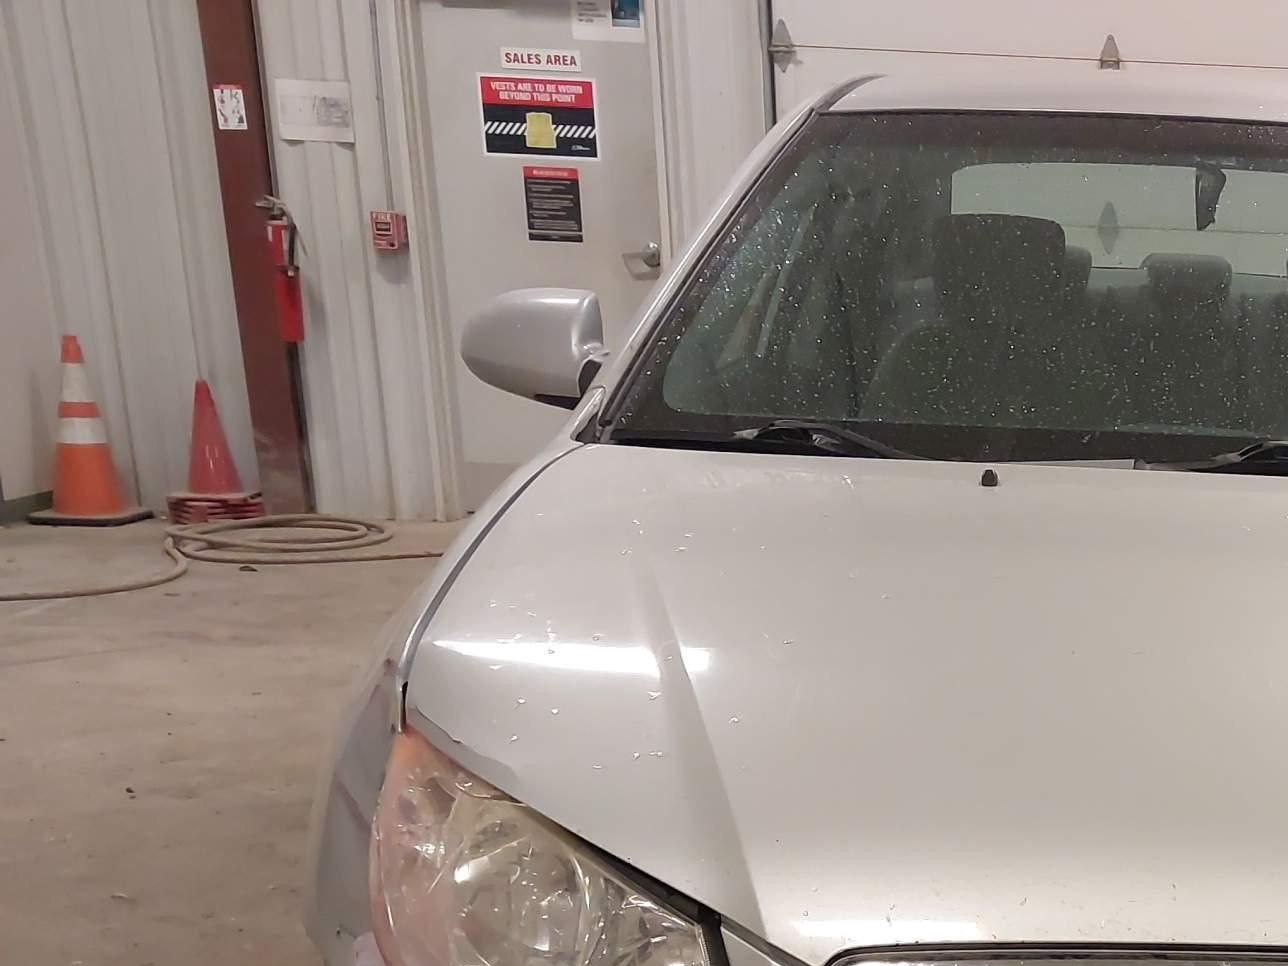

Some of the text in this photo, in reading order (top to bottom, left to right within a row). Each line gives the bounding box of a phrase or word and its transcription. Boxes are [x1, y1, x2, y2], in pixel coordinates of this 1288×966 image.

[504, 52, 577, 67] SALES AREA
[490, 81, 516, 91] VESTS
[517, 82, 533, 92] ARE
[534, 83, 545, 92] TO
[546, 83, 556, 93] BE
[499, 91, 576, 103] BEYOND THIS POINT
